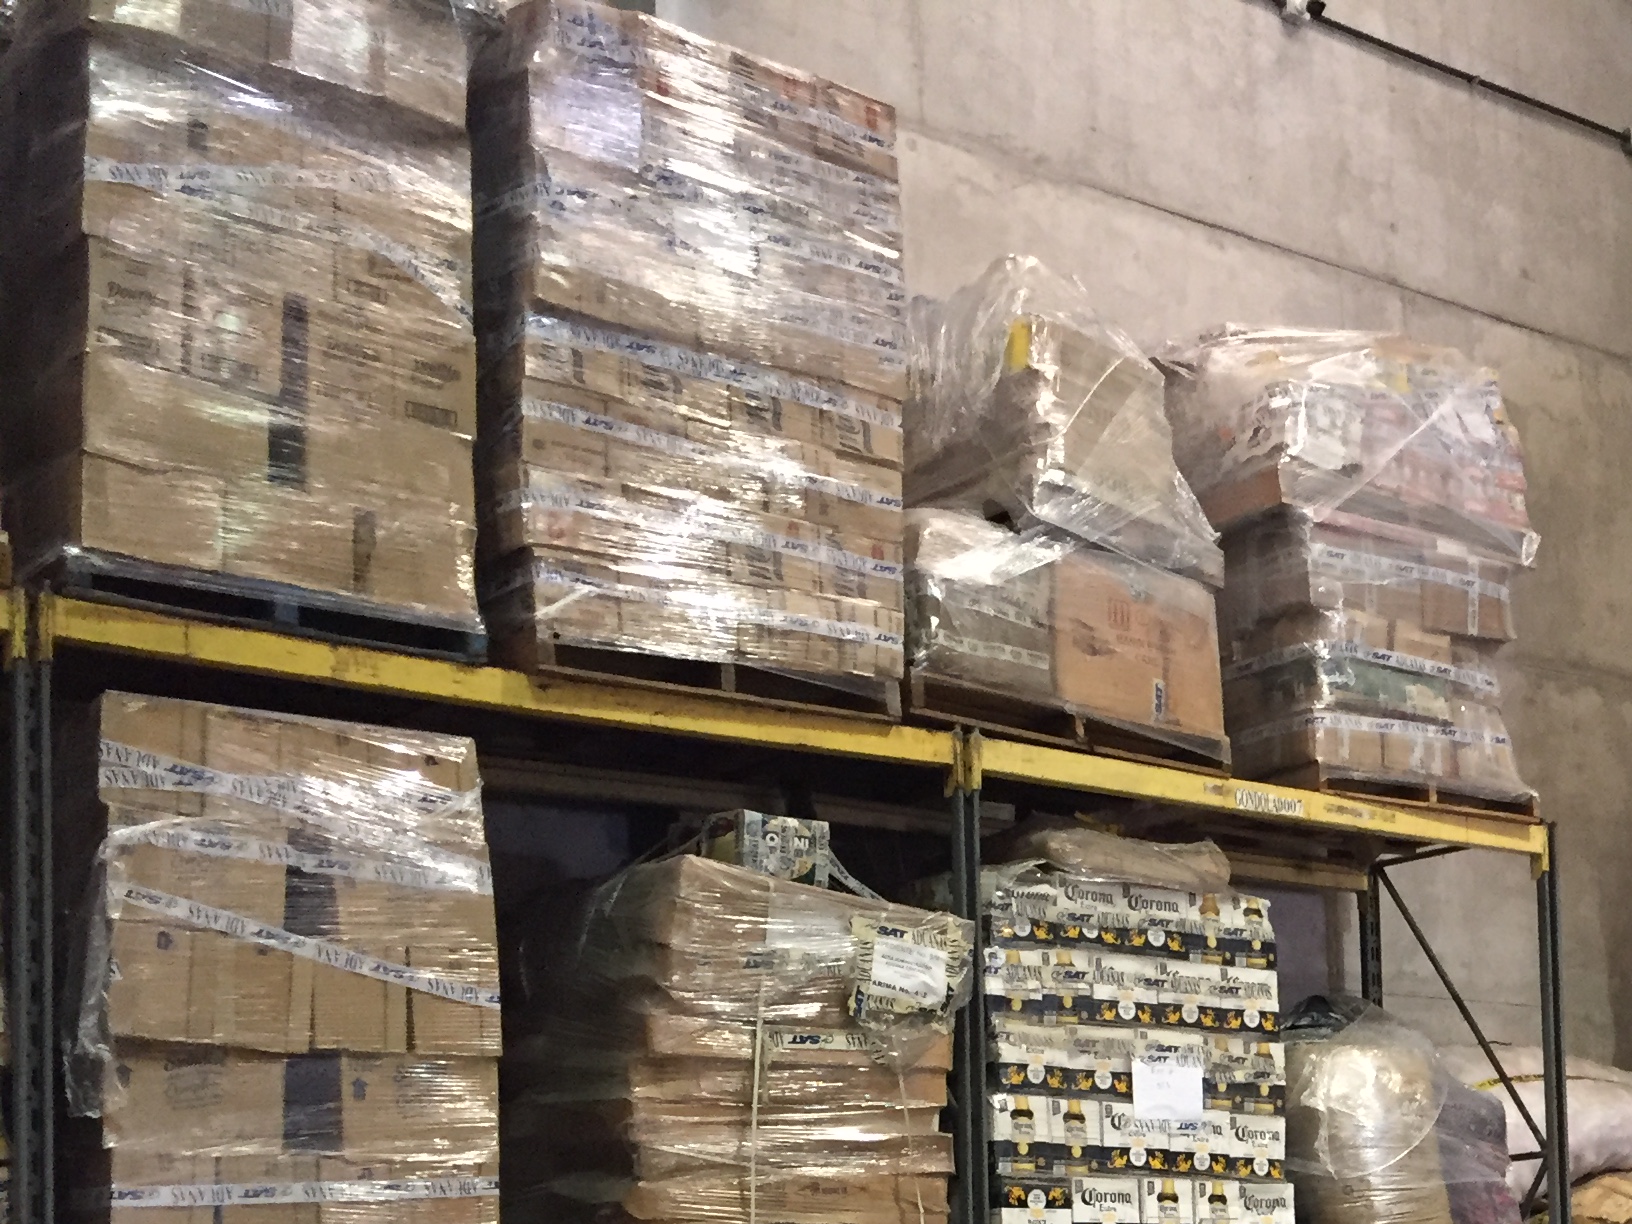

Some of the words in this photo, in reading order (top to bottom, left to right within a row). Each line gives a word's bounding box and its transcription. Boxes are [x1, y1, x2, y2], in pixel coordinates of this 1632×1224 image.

[1372, 651, 1392, 662] SAT
[1064, 882, 1114, 906] Corona
[1127, 894, 1179, 912] Corona
[1067, 912, 1093, 923] SAT
[1148, 918, 1173, 928] SAT
[877, 926, 908, 938] SAT
[872, 980, 897, 991] ARIMA
[1062, 970, 1089, 980] SAT
[1143, 978, 1168, 988] SAT
[1220, 986, 1242, 995] SAT
[788, 1035, 822, 1044] SAT
[1235, 1125, 1280, 1143] Corona
[1081, 1187, 1132, 1205] Corona
[1244, 1194, 1287, 1209] Corona
[1099, 1205, 1117, 1213] Extra
